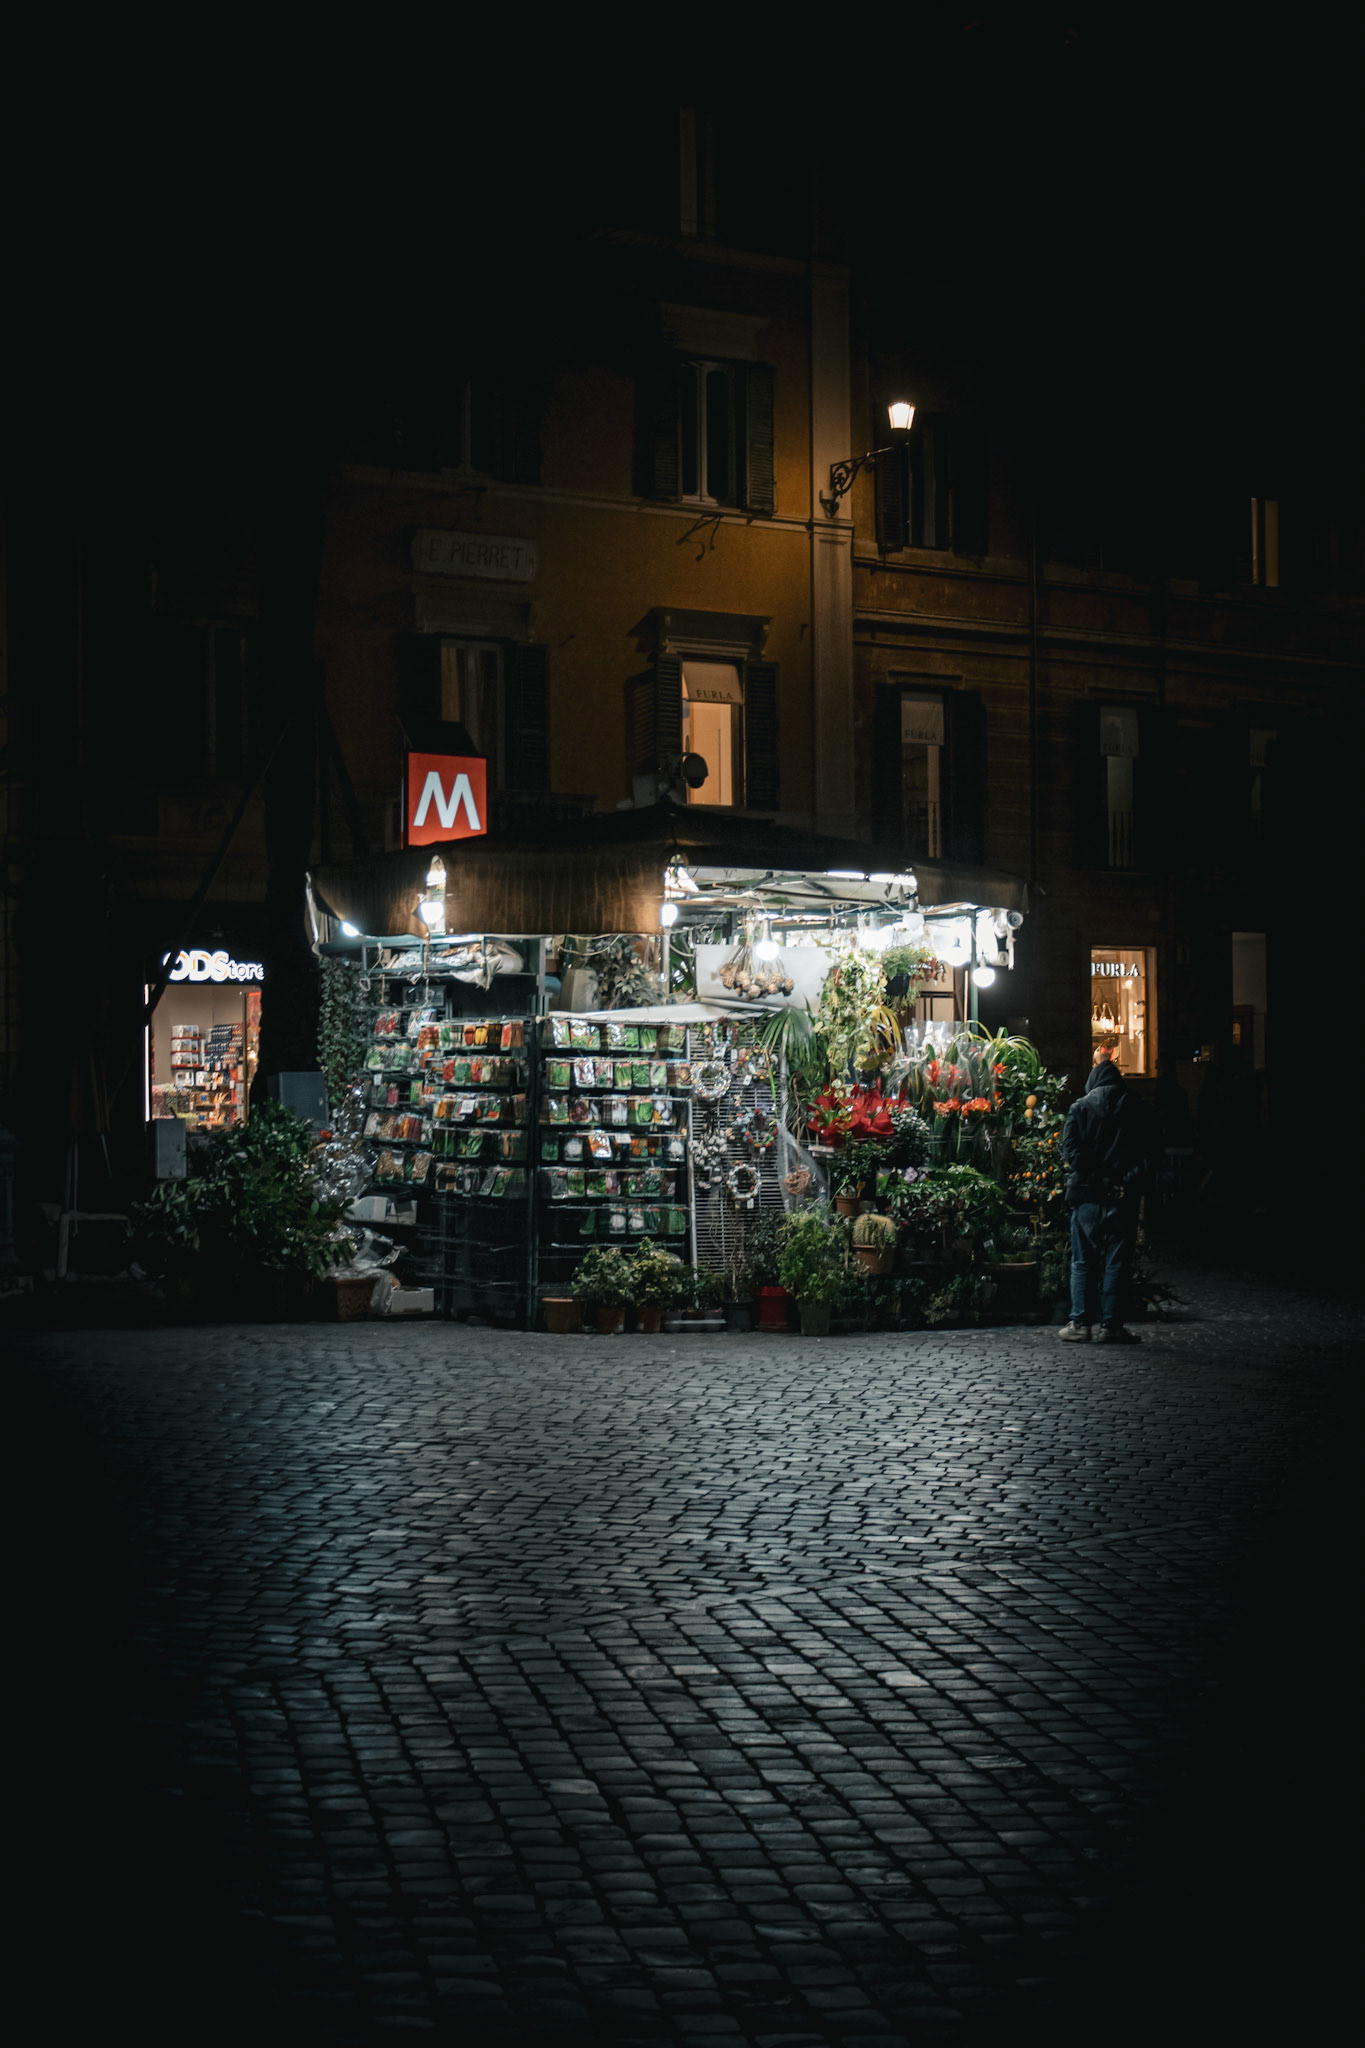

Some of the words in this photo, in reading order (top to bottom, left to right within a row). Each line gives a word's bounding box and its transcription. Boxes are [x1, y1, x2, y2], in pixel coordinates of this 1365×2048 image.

[696, 689, 734, 700] FURLA
[413, 770, 482, 831] M
[1090, 962, 1141, 977] FURLA
